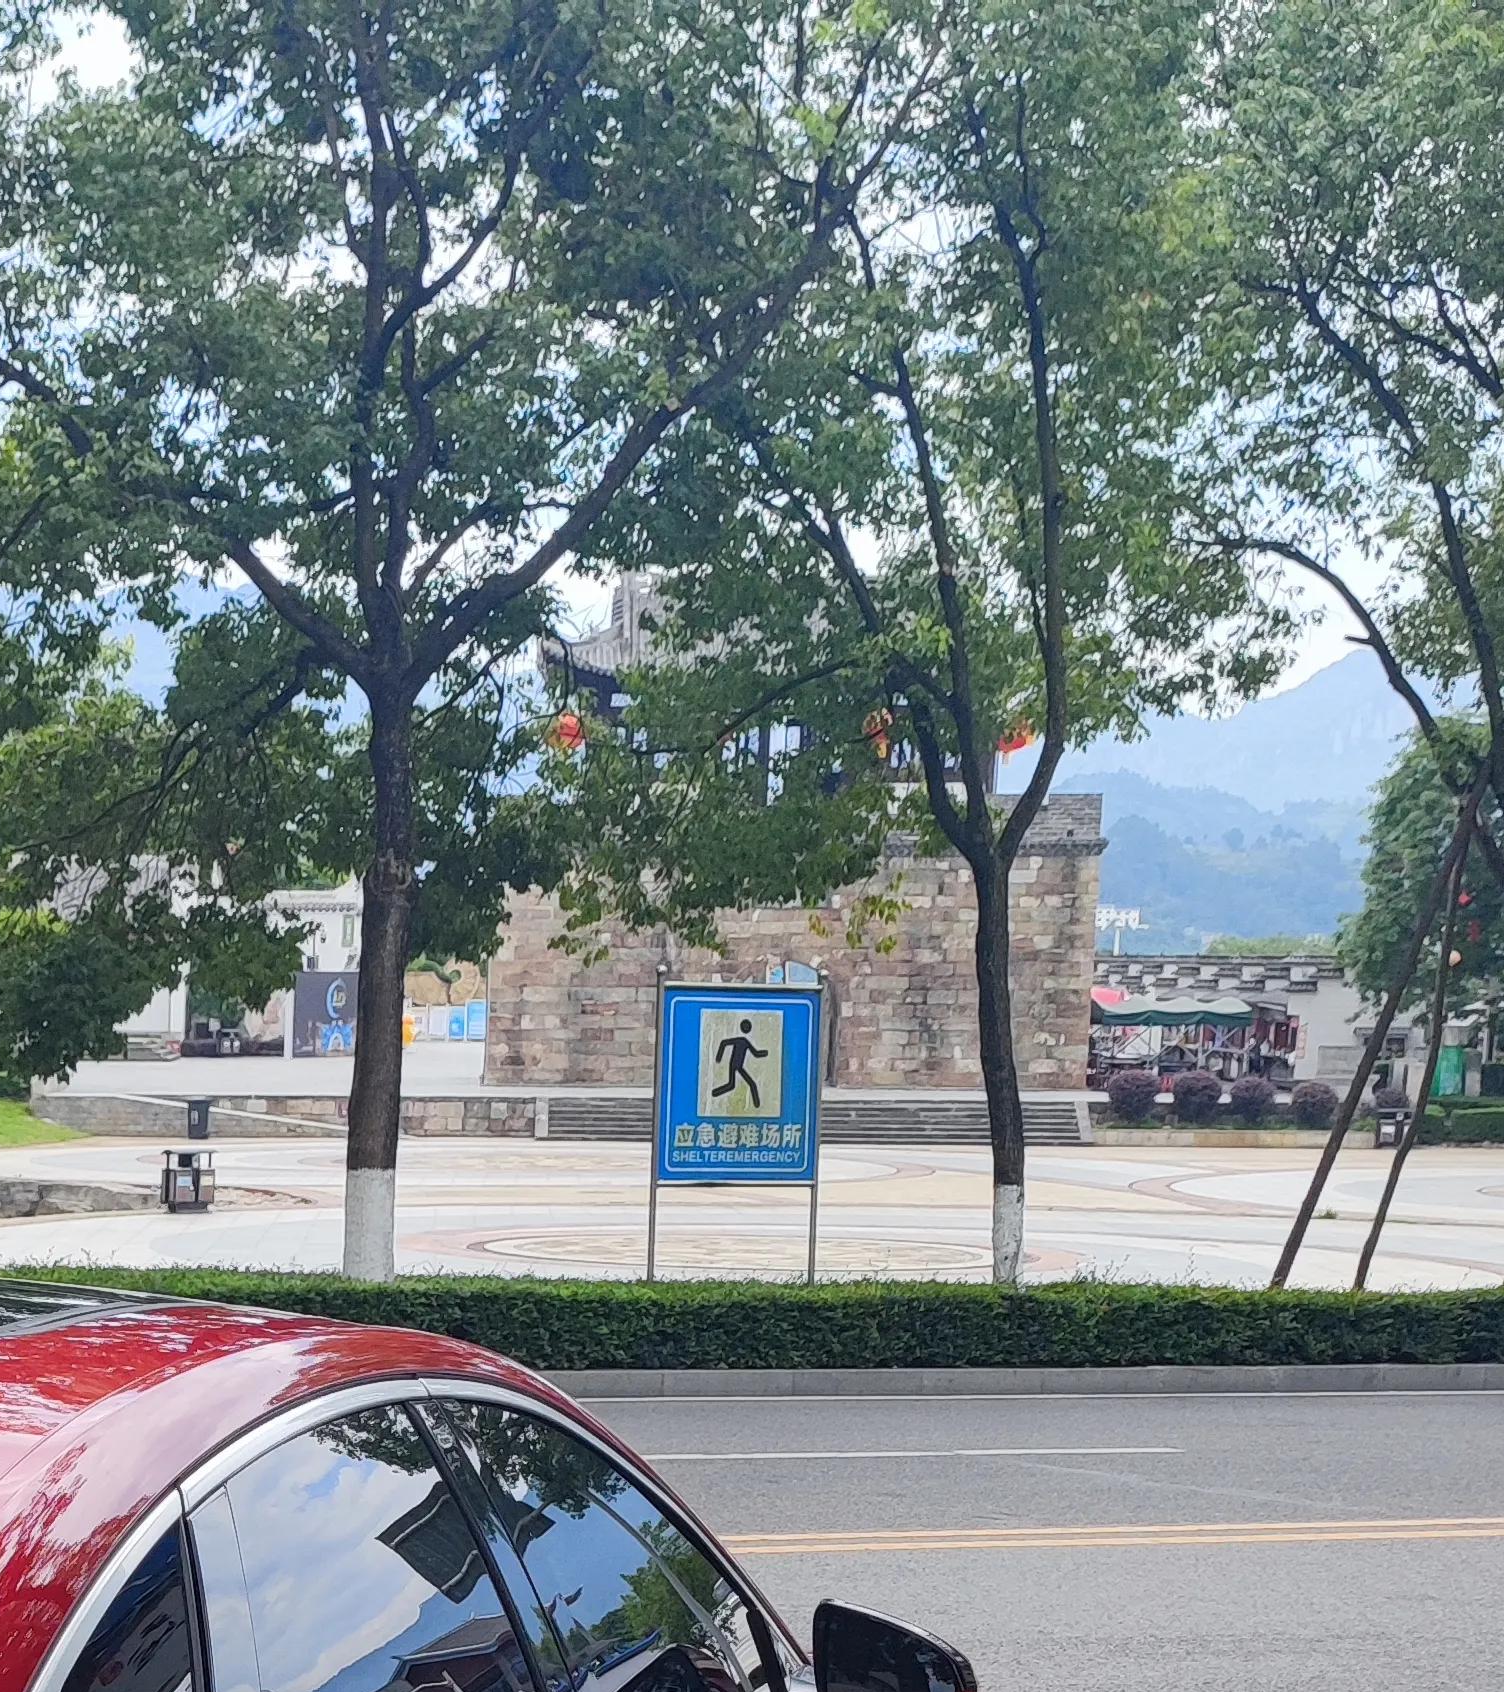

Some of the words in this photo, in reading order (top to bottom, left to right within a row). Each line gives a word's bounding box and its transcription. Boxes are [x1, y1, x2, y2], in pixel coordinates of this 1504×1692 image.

[674, 1123, 802, 1148] 应急避难场所
